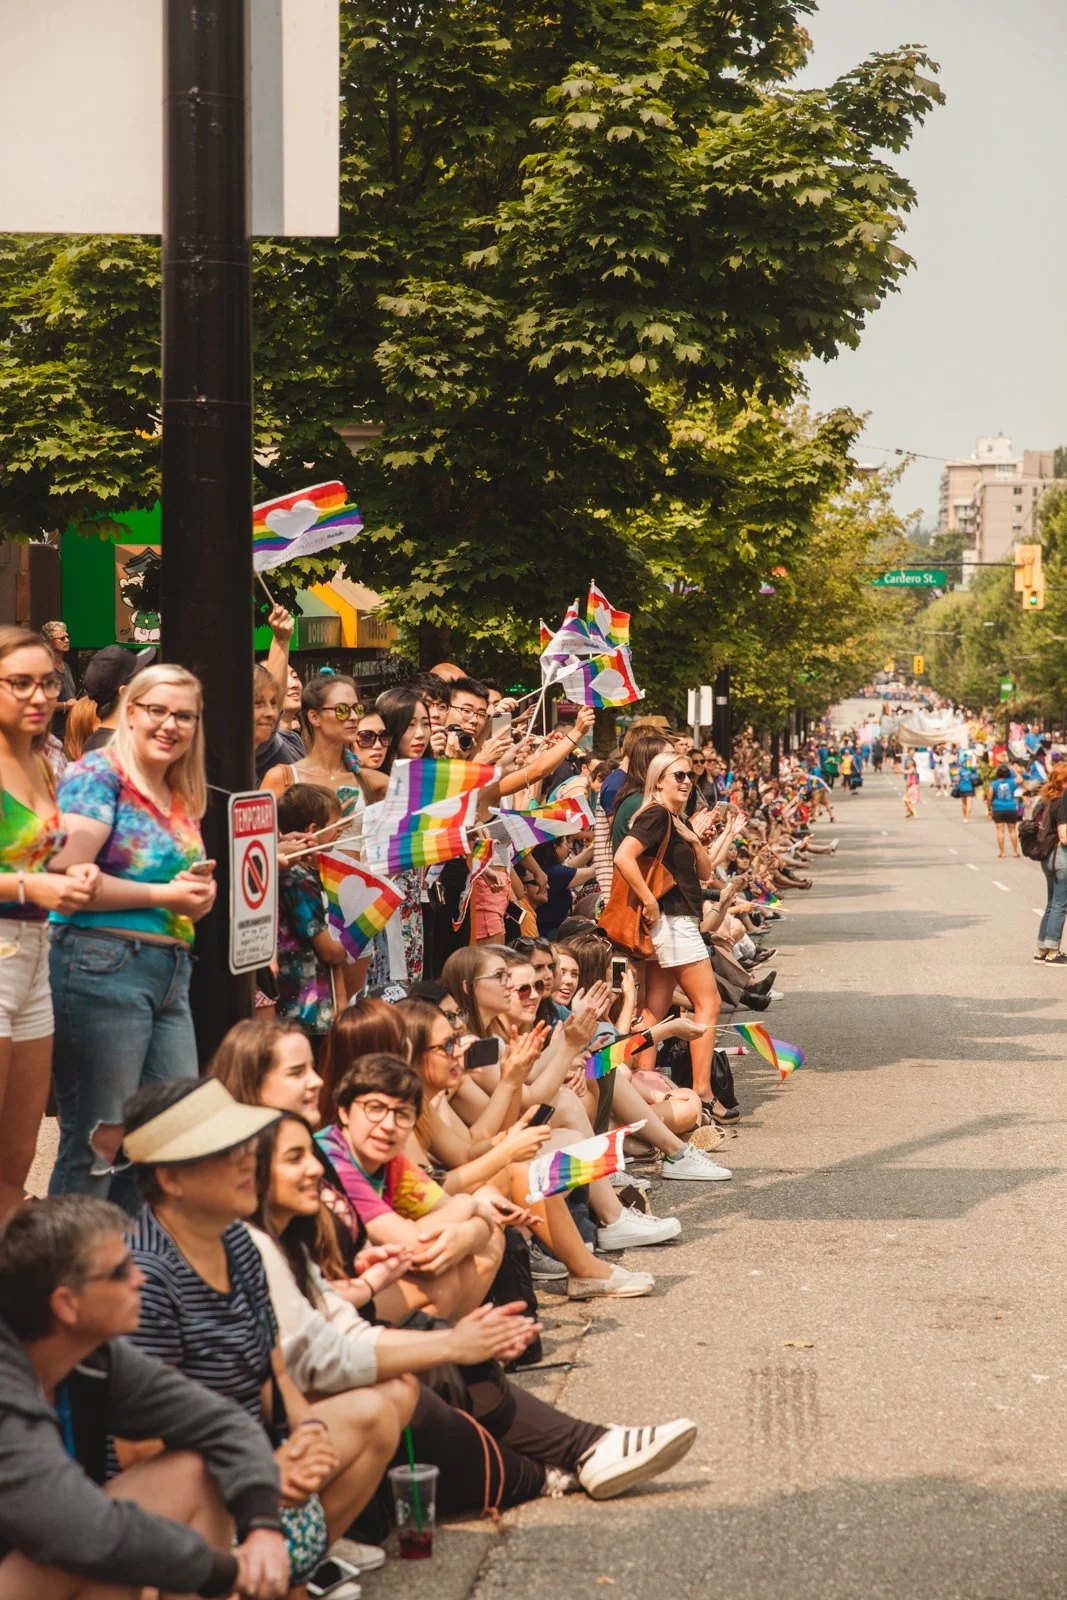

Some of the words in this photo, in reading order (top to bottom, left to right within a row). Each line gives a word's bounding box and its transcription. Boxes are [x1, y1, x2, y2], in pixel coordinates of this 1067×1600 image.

[884, 571, 921, 584] Cardero
[923, 573, 936, 583] St.
[234, 804, 273, 833] TEMPORARY
